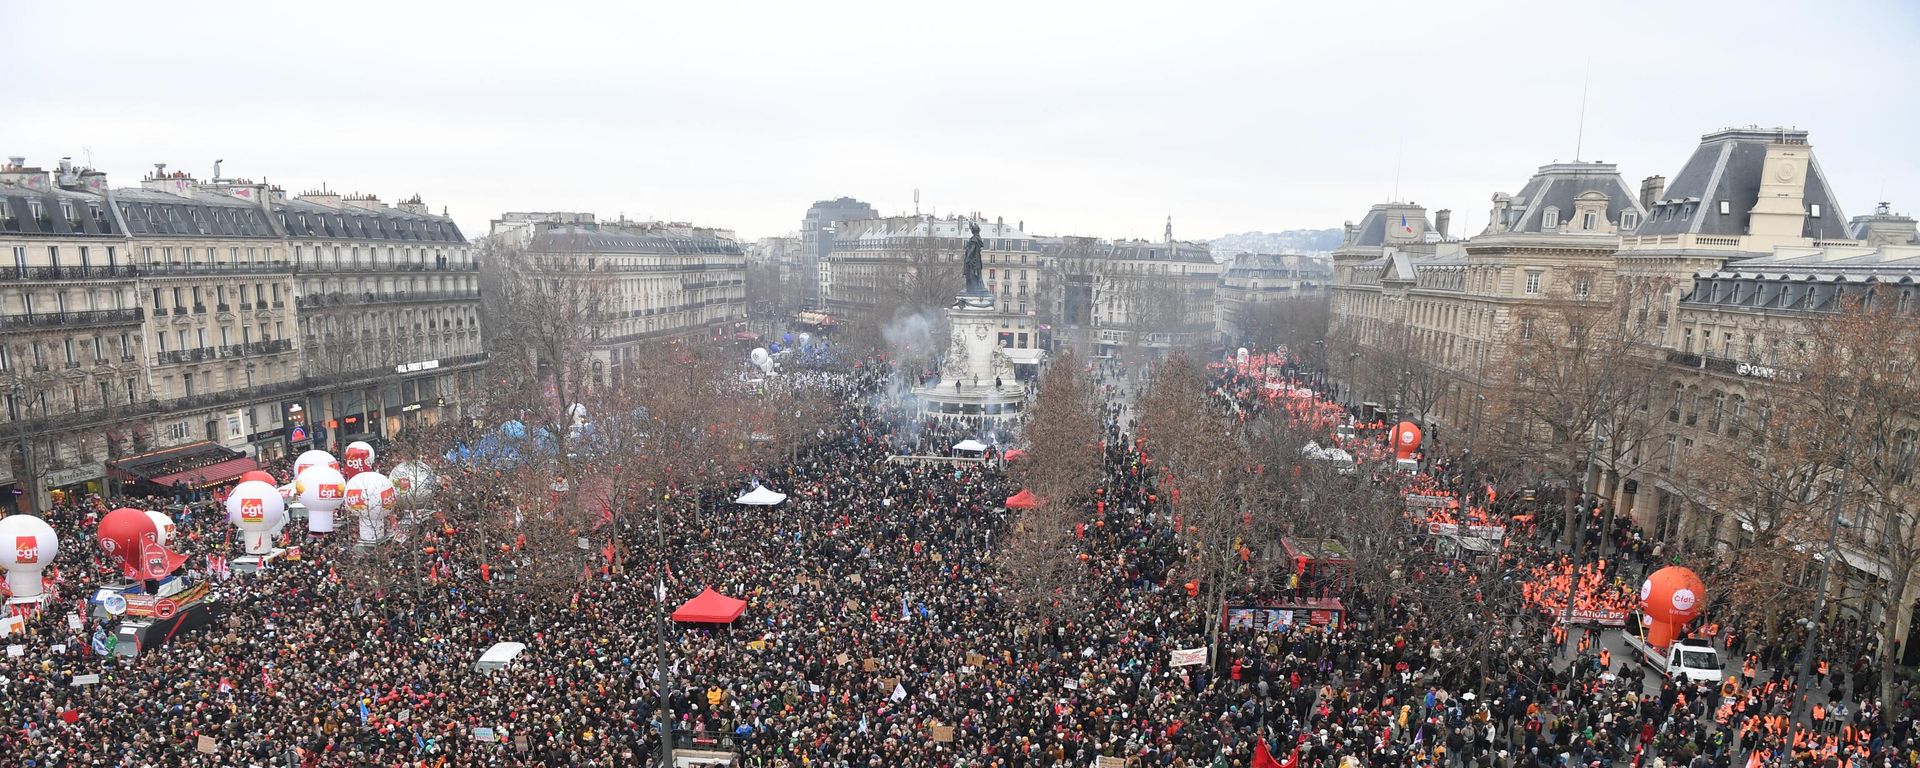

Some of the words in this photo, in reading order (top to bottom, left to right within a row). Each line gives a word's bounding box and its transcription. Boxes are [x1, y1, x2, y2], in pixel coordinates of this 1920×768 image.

[346, 457, 363, 468] cgt
[320, 488, 336, 498] cgt
[241, 504, 263, 517] cgt
[16, 546, 39, 559] cgt
